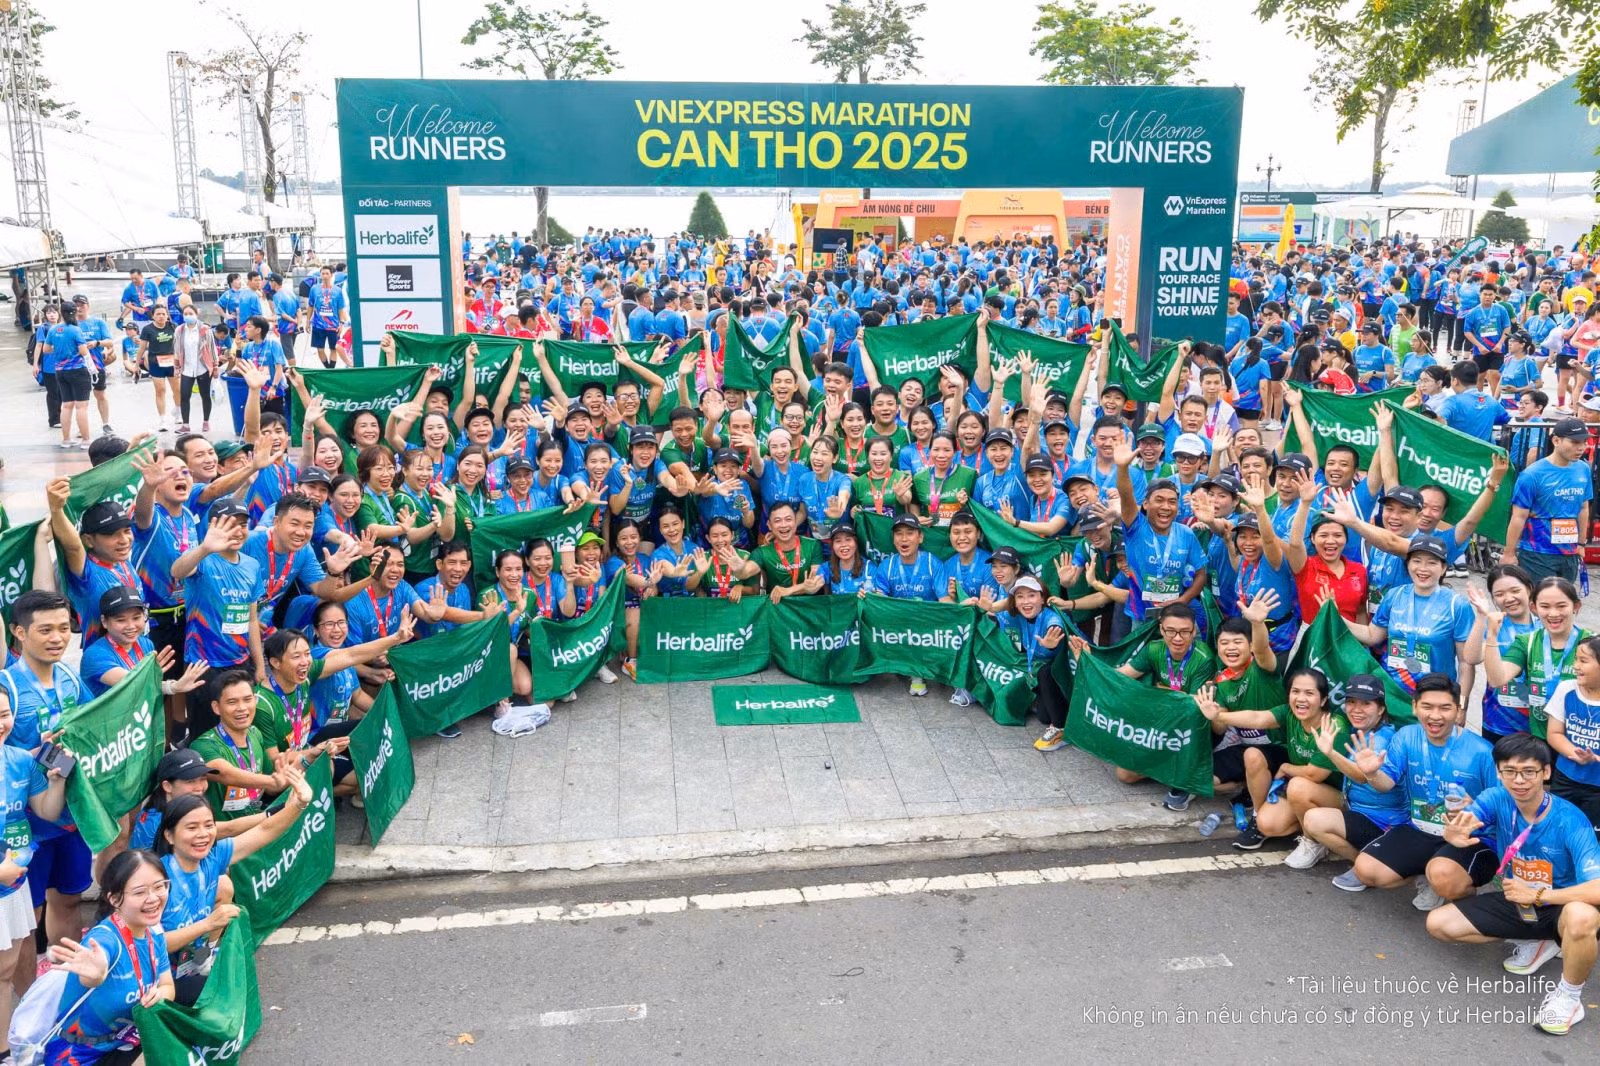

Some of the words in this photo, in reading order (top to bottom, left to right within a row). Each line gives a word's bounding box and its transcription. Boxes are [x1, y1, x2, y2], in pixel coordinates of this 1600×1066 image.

[376, 104, 496, 141] Welcome
[635, 99, 805, 126] VNEXPRESS
[811, 102, 971, 126] MARATHON
[1099, 110, 1206, 144] Welcome
[370, 136, 506, 161] RUNNERS
[636, 129, 739, 169] CAN
[748, 129, 843, 170] THO
[853, 132, 968, 171] 2025
[1090, 140, 1212, 165] RUNNERS
[394, 199, 432, 207] PARTNERS
[1186, 197, 1227, 206] VnExpress
[1186, 207, 1226, 215] Marathon
[360, 230, 429, 246] Herbalife
[1159, 247, 1223, 272] RUN
[388, 273, 401, 281] Key
[1159, 274, 1189, 284] YOUR
[1190, 274, 1221, 284] RACE
[1157, 286, 1220, 305] SHINE
[1157, 306, 1189, 316] YOUR
[1190, 305, 1218, 316] WAY
[656, 631, 745, 653] Herbalife
[872, 626, 963, 651] Herbalife
[405, 657, 484, 703] Herbalife
[735, 697, 829, 711] Herbalife
[1086, 697, 1182, 752] Herbalife
[1515, 866, 1550, 882] 81932
